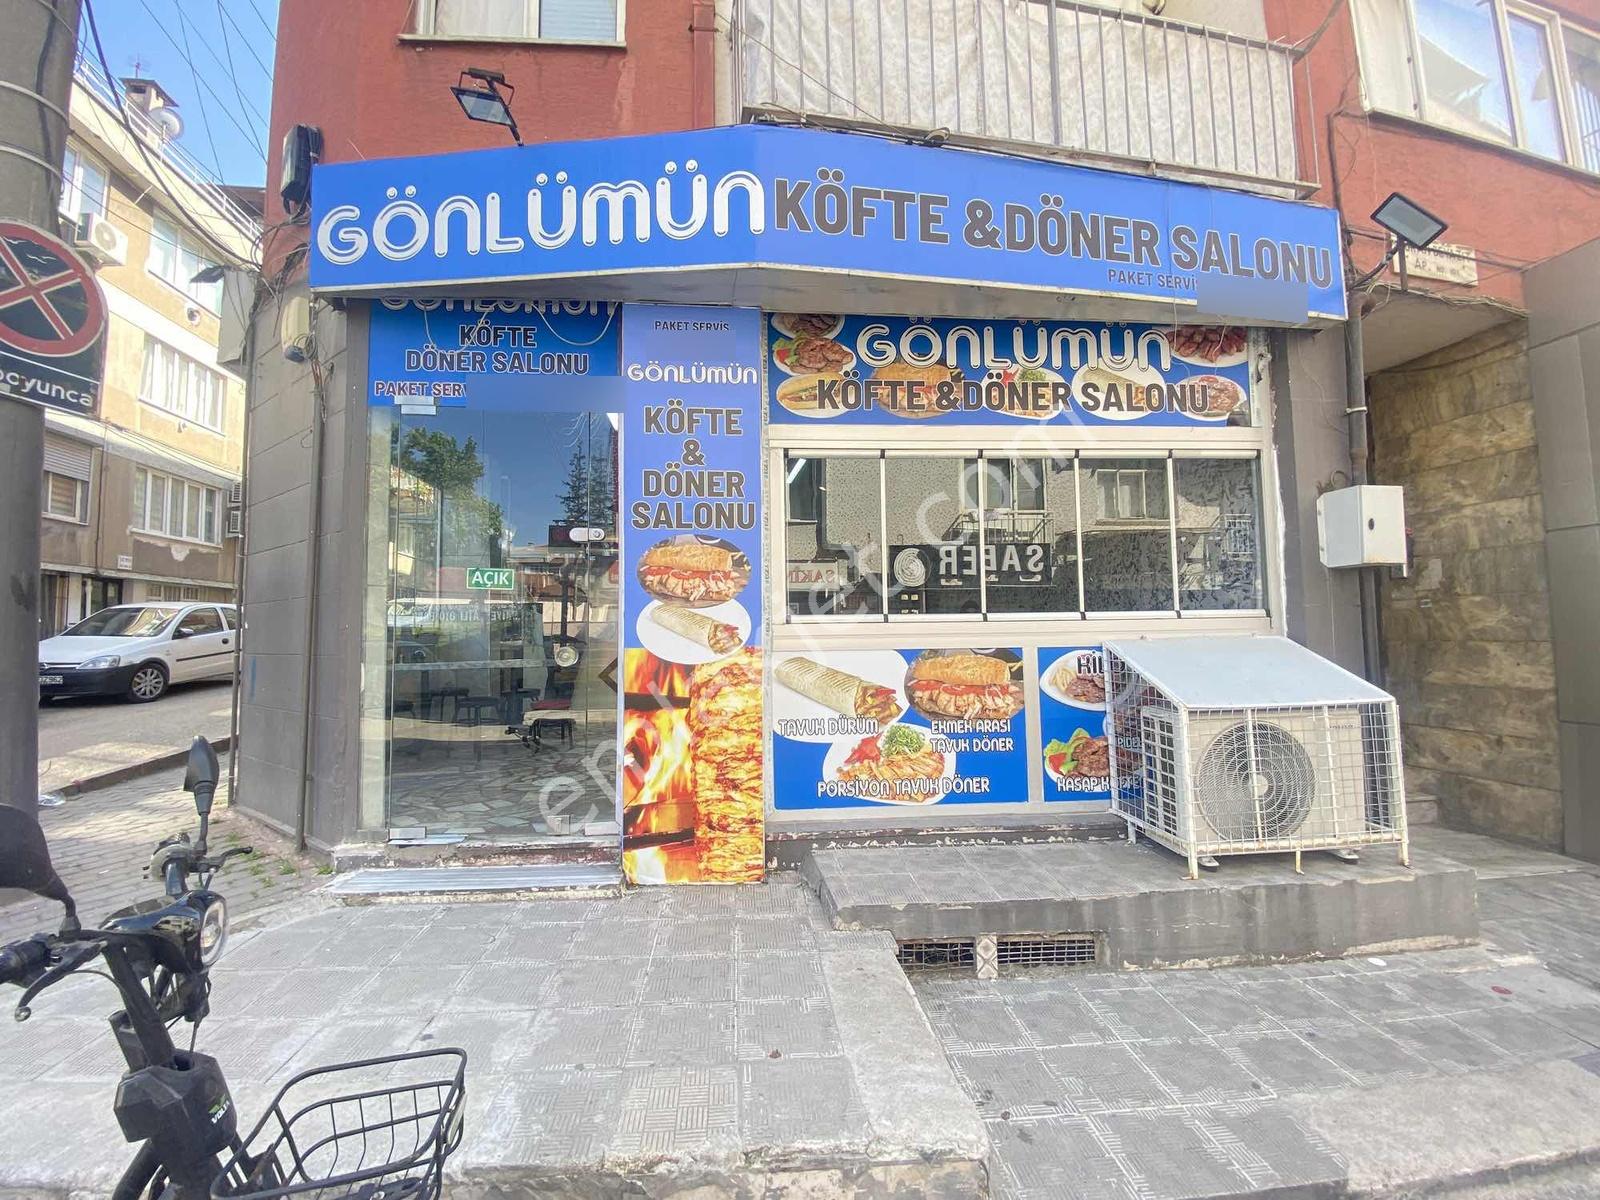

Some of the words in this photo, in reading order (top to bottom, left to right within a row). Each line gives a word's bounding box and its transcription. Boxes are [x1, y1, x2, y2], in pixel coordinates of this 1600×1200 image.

[316, 159, 765, 266] GÖNLÜMÜN
[773, 167, 950, 245] KÖFTE
[1170, 223, 1333, 290] SALONU
[1107, 268, 1153, 286] PAKET
[1157, 274, 1198, 291] SERVİ
[459, 319, 537, 348] KÖFTE
[654, 320, 690, 331] PAKET
[692, 320, 729, 331] SERVİS
[855, 317, 1172, 372] GÖNLÜMÜN
[405, 343, 487, 372] DÖNER
[492, 351, 589, 374] SALONU
[627, 360, 758, 384] GÖNLÜMÜN
[374, 381, 428, 397] PAKET
[815, 370, 926, 412] KÖFTE
[1079, 378, 1209, 415] SALONU
[643, 399, 743, 436] KÖFTE
[681, 438, 705, 467] &
[642, 462, 745, 499] DÖNER
[631, 501, 756, 531] SALONU
[471, 572, 509, 588] AÇIK
[778, 718, 825, 736] TAVUK
[827, 716, 879, 735] DÜRÜM
[931, 719, 974, 735] EKMEK
[930, 737, 969, 753] TAVUK
[972, 735, 1013, 752] DÖNER
[817, 778, 890, 798] PORSİYON
[894, 778, 940, 796] TAVUK
[942, 776, 990, 794] DÖNER
[1057, 776, 1098, 792] KASAP
